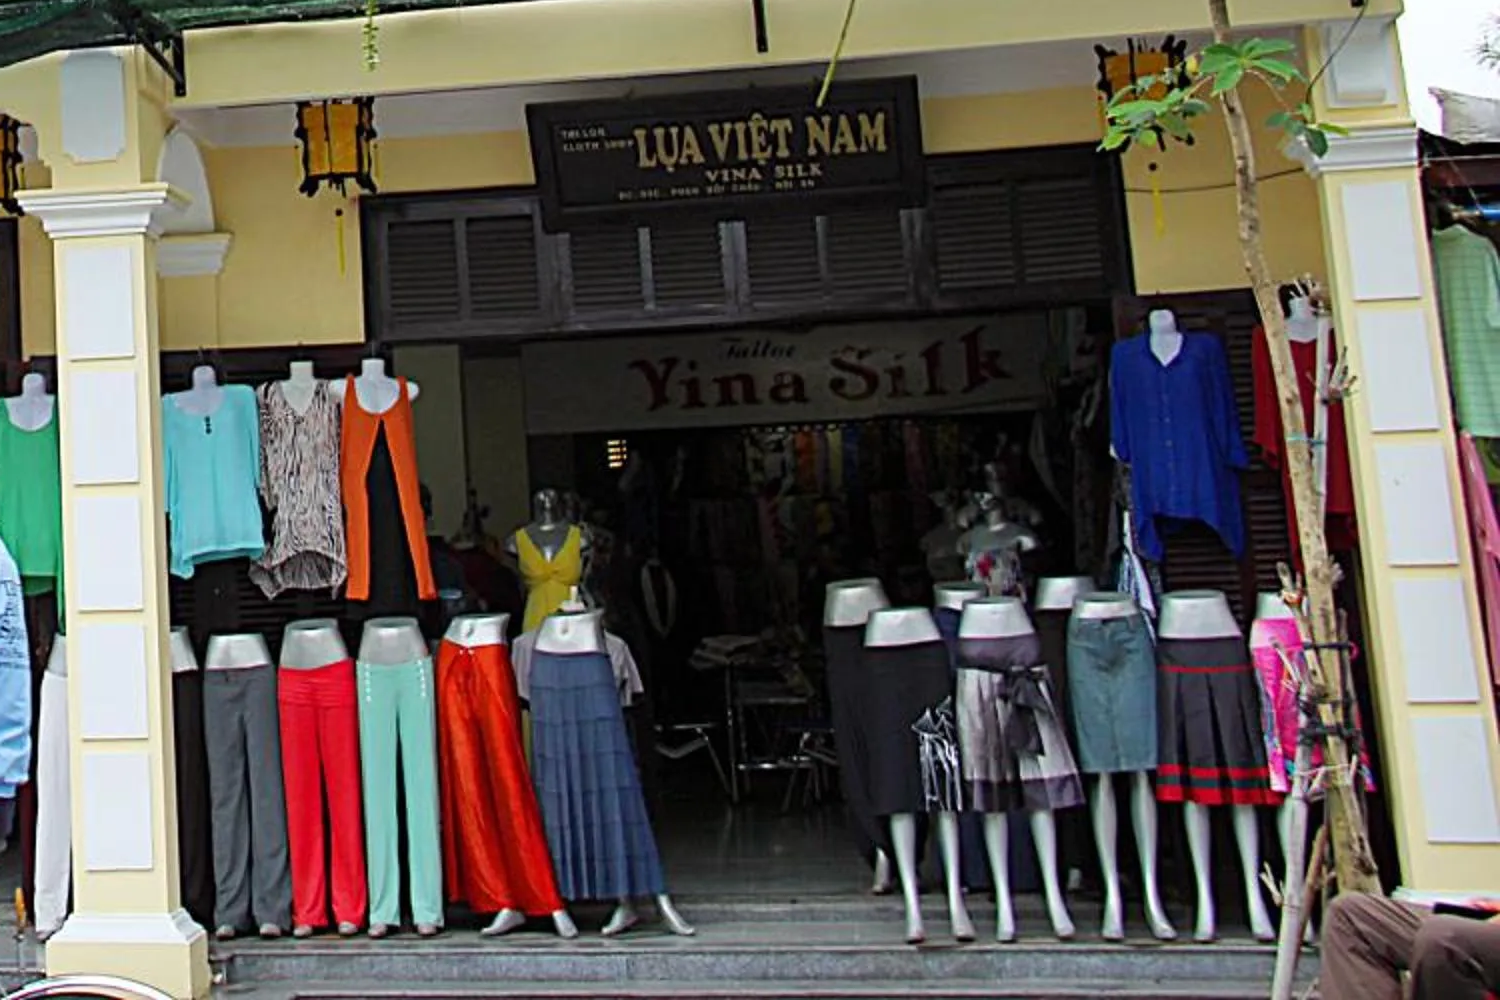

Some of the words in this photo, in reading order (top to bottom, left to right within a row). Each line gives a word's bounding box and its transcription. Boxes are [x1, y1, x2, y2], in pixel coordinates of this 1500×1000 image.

[632, 125, 704, 173] LỤA
[707, 112, 793, 166] VIỆT
[804, 111, 887, 157] NAM
[705, 167, 763, 186] VINA
[774, 162, 823, 179] SILK
[829, 325, 1012, 402] Silk
